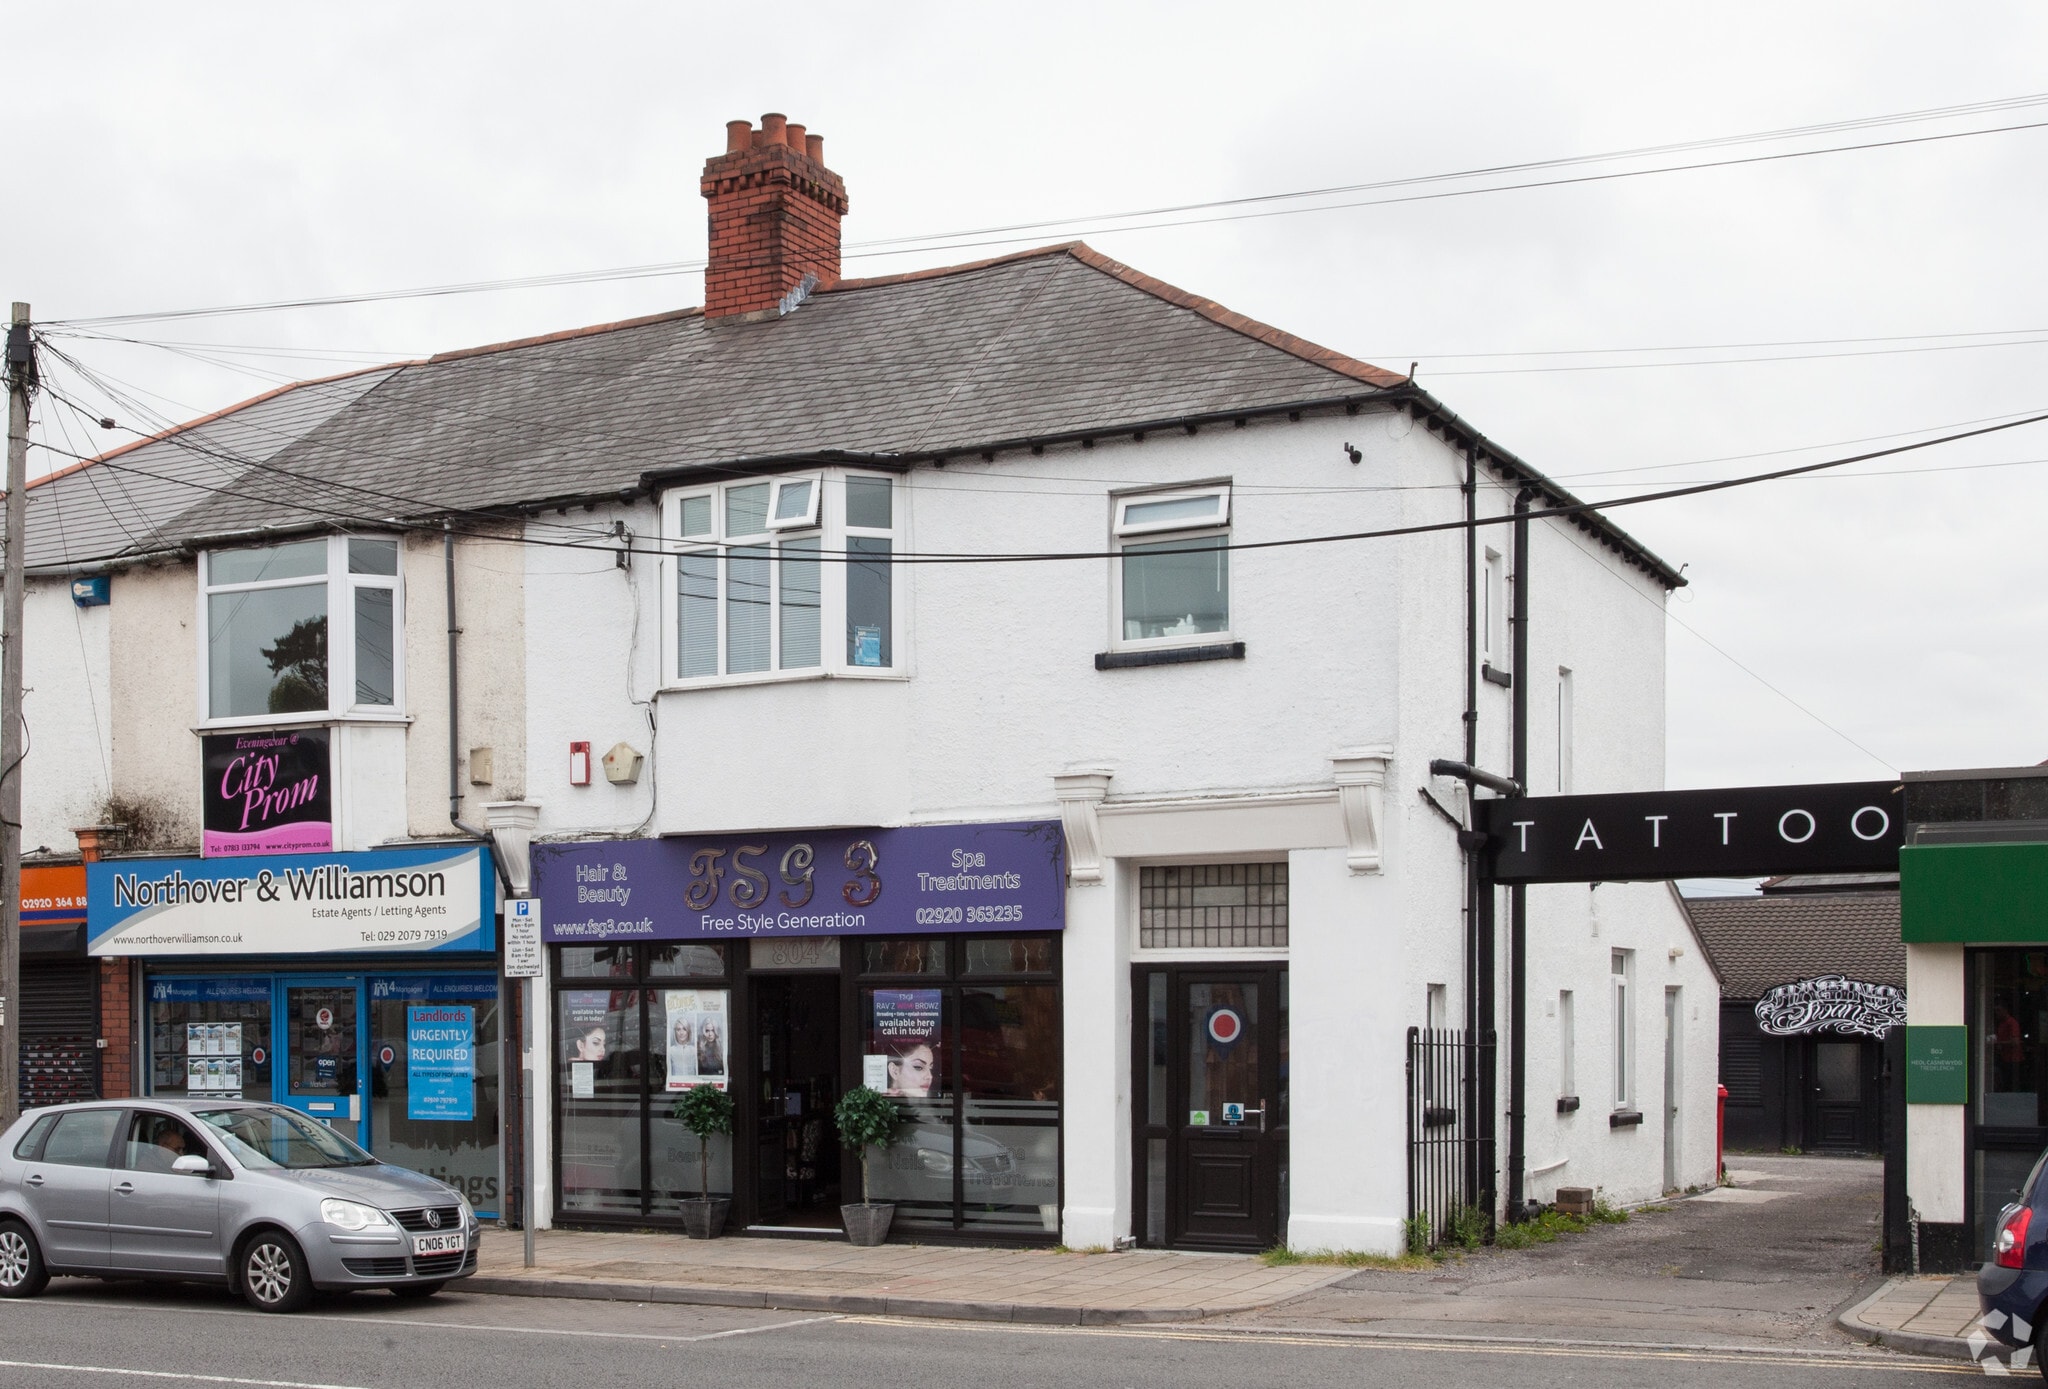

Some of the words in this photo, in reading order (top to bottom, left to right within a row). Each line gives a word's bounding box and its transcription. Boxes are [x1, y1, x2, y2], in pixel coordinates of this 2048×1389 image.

[236, 735, 288, 750] Eveningwear
[221, 751, 279, 800] City
[238, 774, 319, 831] Prom
[1512, 806, 1890, 853] TATTOO
[210, 845, 222, 853] Tel:
[265, 840, 330, 850] www.cityprom.co.uk
[951, 848, 986, 873] Spa
[576, 863, 609, 882] Hair
[612, 863, 628, 881] &
[841, 839, 882, 908] 3
[917, 871, 1021, 892] Treatments
[114, 870, 250, 907] Northover
[256, 869, 281, 903] &
[284, 864, 446, 901] Williamson
[22, 898, 52, 909] 02920
[55, 896, 73, 908] 364
[577, 885, 631, 907] Beauty
[312, 907, 339, 918] Estate
[341, 907, 372, 920] Agents
[381, 906, 413, 918] Letting
[415, 905, 447, 918] Agents
[915, 906, 963, 925] 02920
[966, 904, 1023, 923] 363235
[553, 917, 654, 938] www.fsg3.co.uk
[701, 914, 734, 931] Free
[737, 913, 774, 934] Style
[777, 912, 866, 930] Generation
[113, 932, 243, 945] www.northoverwilliamson.co.uk
[360, 931, 376, 942] Tel:
[377, 931, 396, 941] 029
[398, 930, 422, 940] 2079
[424, 930, 448, 940] 7919
[772, 940, 820, 965] 804
[414, 1010, 466, 1022] Landlords
[880, 1018, 915, 1027] available
[917, 1018, 935, 1027] here
[411, 1029, 468, 1041] URGENTLY
[882, 1027, 898, 1035] call
[900, 1027, 907, 1035] in
[909, 1027, 932, 1037] today!
[412, 1048, 468, 1063] REQUIRED
[419, 1237, 444, 1252] CN06
[444, 1235, 461, 1249] YGT
